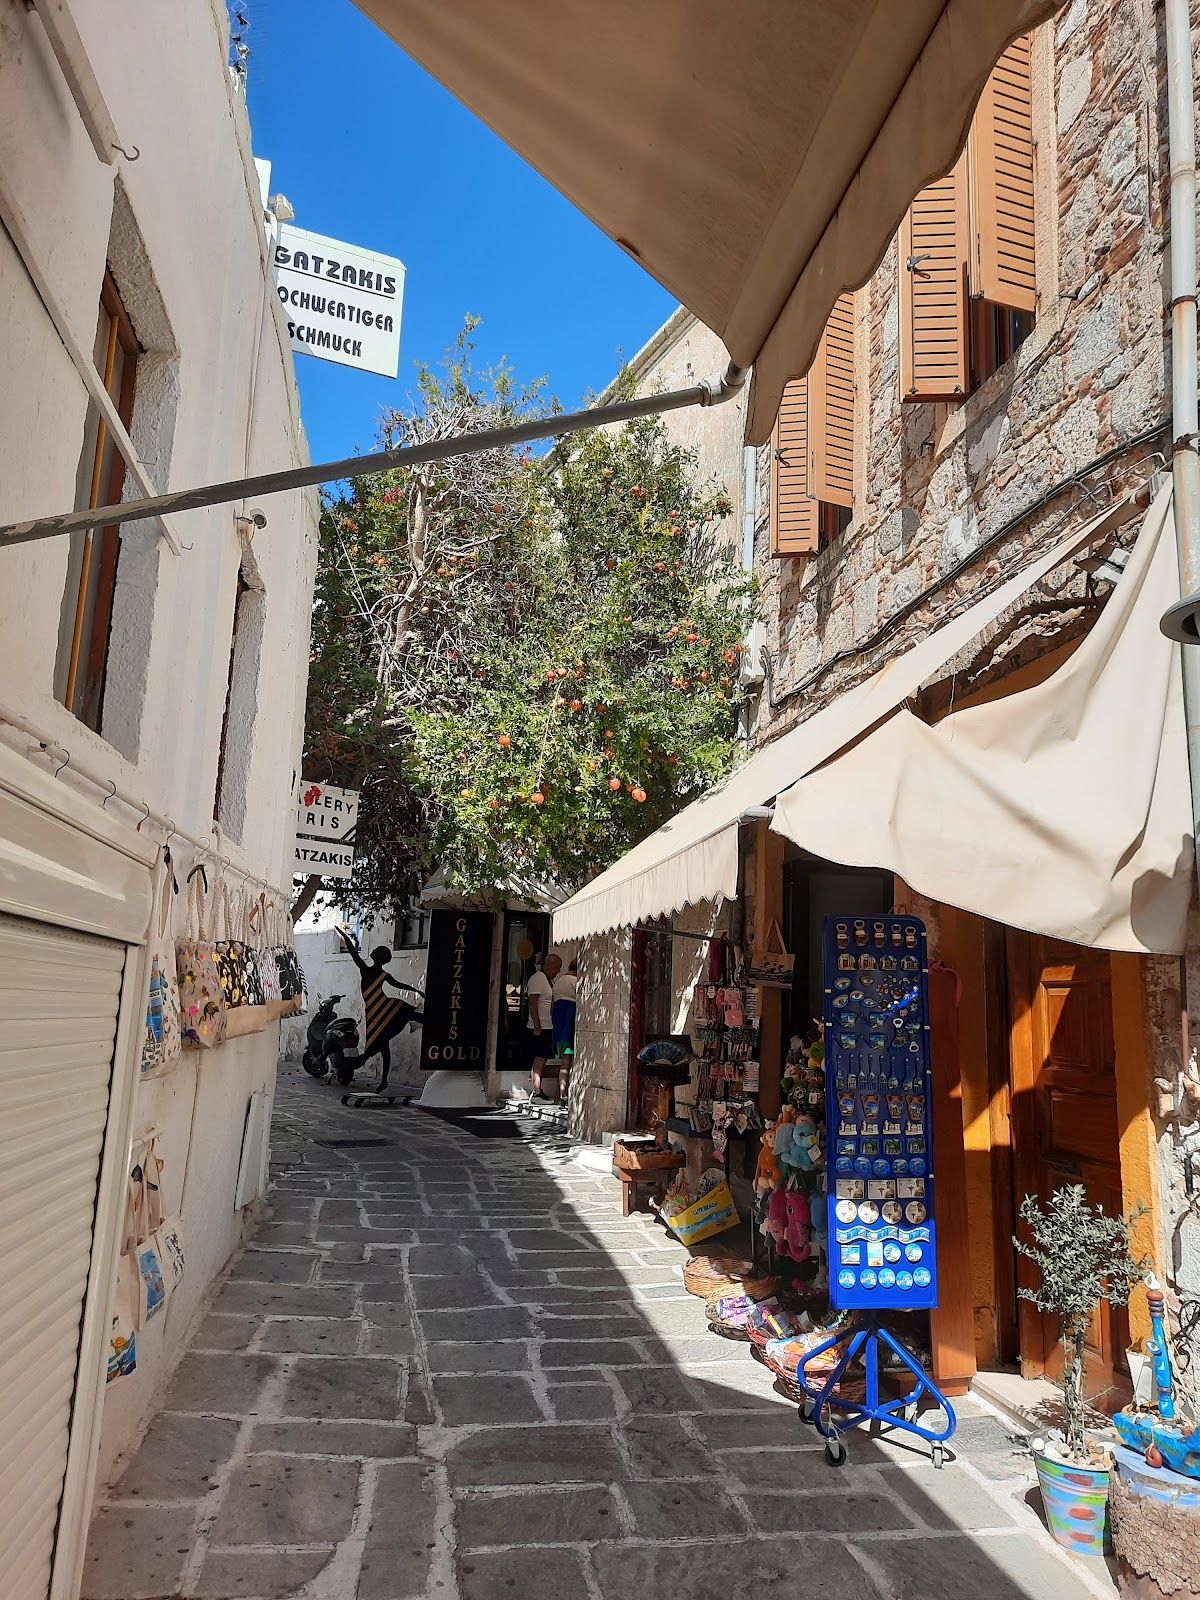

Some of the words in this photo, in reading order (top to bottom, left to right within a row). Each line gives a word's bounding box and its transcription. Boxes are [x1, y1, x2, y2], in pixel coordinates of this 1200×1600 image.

[274, 245, 396, 294] GATZAKIS
[287, 321, 362, 357] SCHMUCK
[298, 792, 354, 815] LERY
[448, 918, 467, 1041] GATZAKIS
[428, 1045, 481, 1061] GOLD
